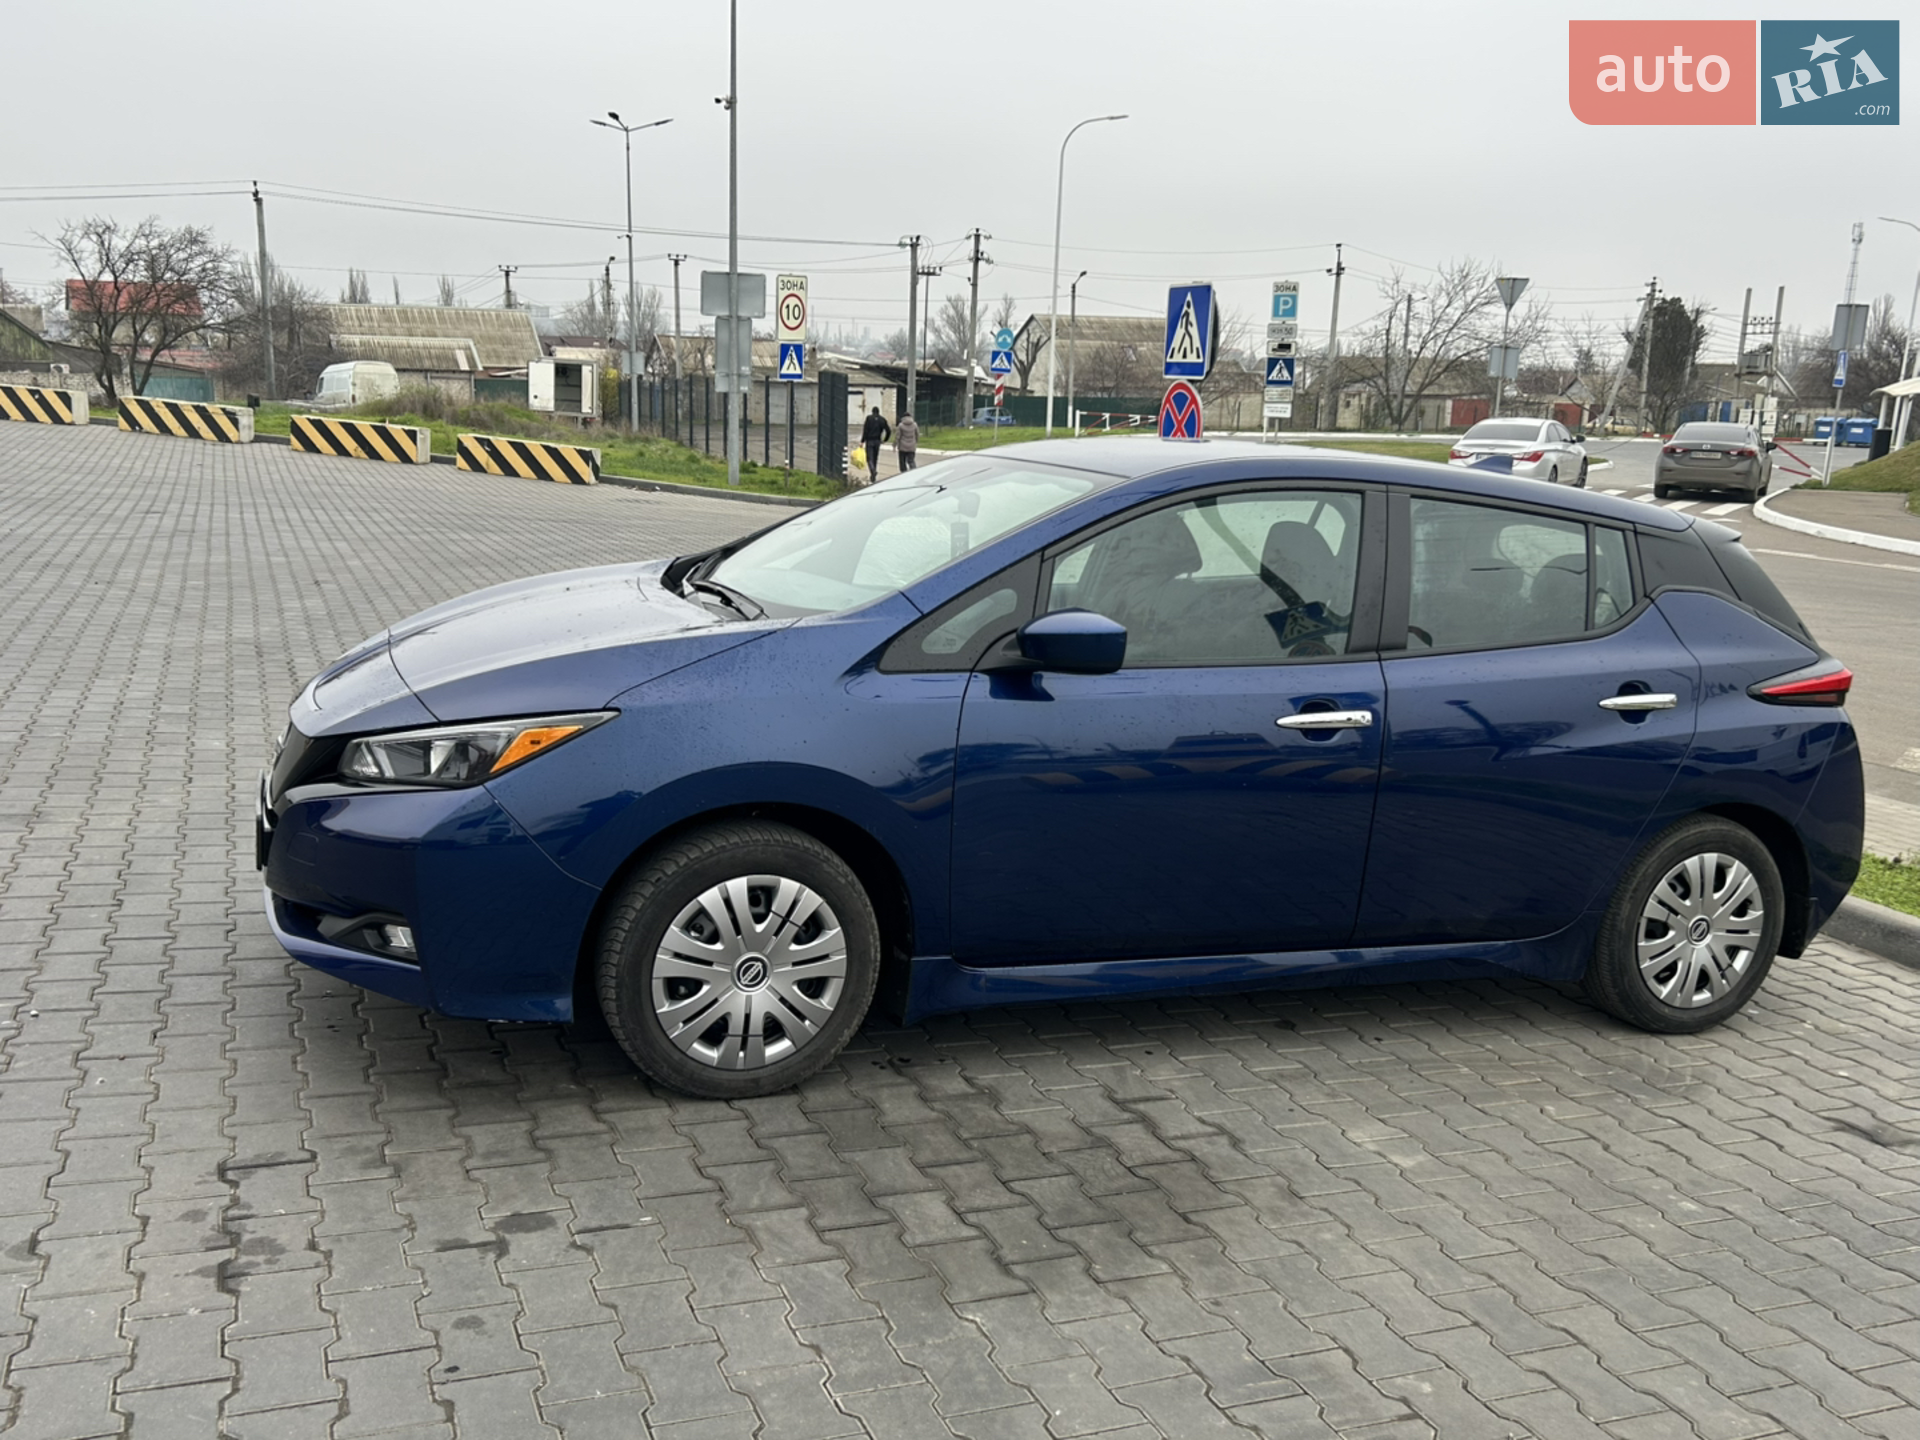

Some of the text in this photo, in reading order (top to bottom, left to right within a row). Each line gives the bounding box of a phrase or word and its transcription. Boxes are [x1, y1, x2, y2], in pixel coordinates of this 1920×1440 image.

[780, 280, 805, 291] ЗОНА
[1274, 284, 1298, 293] ЗОНА
[785, 304, 801, 321] 10
[1279, 297, 1293, 316] P
